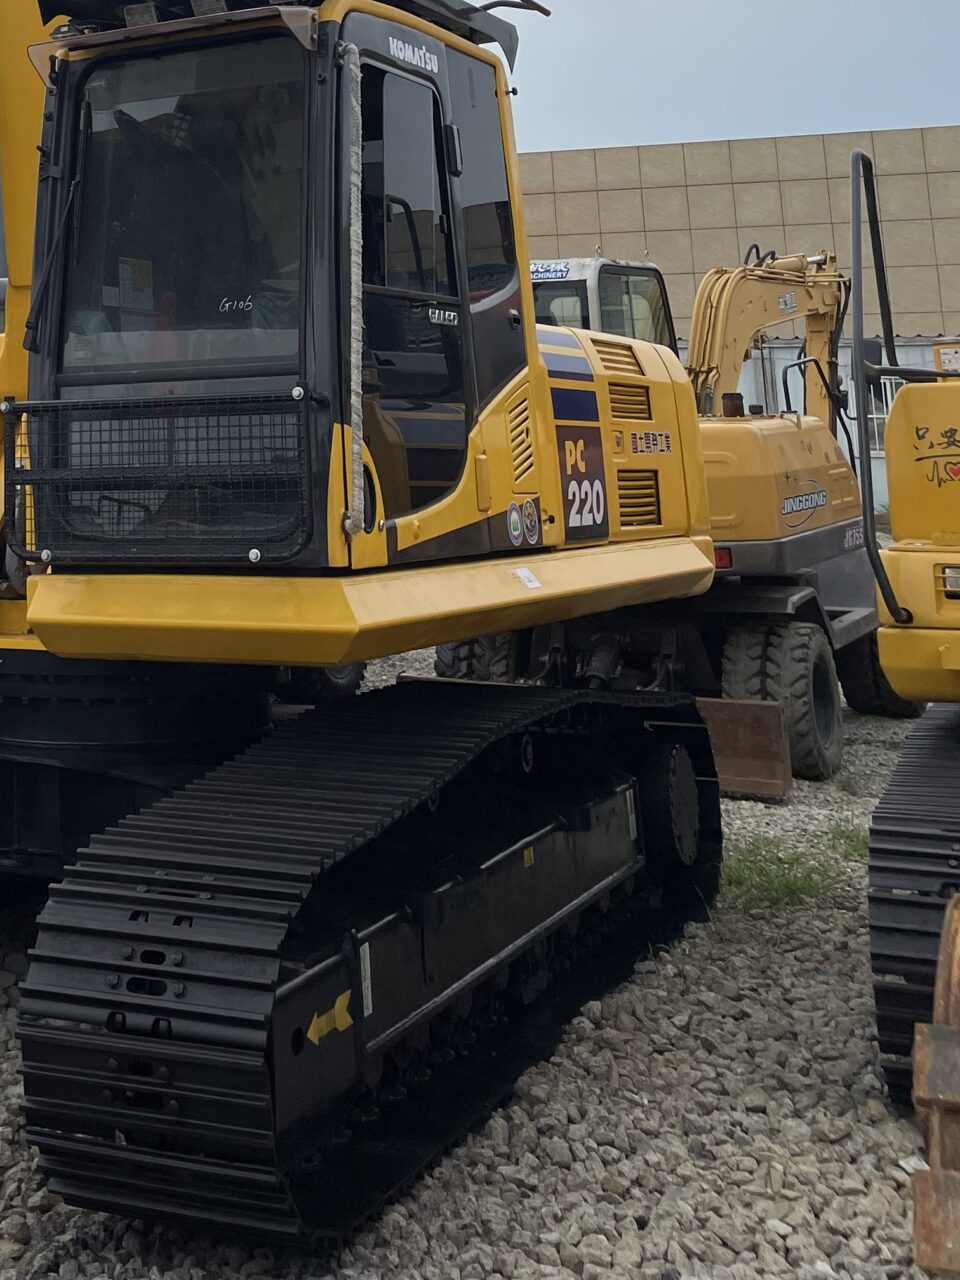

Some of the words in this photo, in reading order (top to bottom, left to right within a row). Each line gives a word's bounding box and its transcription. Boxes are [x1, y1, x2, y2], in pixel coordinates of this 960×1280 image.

[388, 36, 439, 73] KOMATSU
[219, 295, 253, 312] G106
[565, 439, 586, 475] PC
[567, 479, 604, 527] 220
